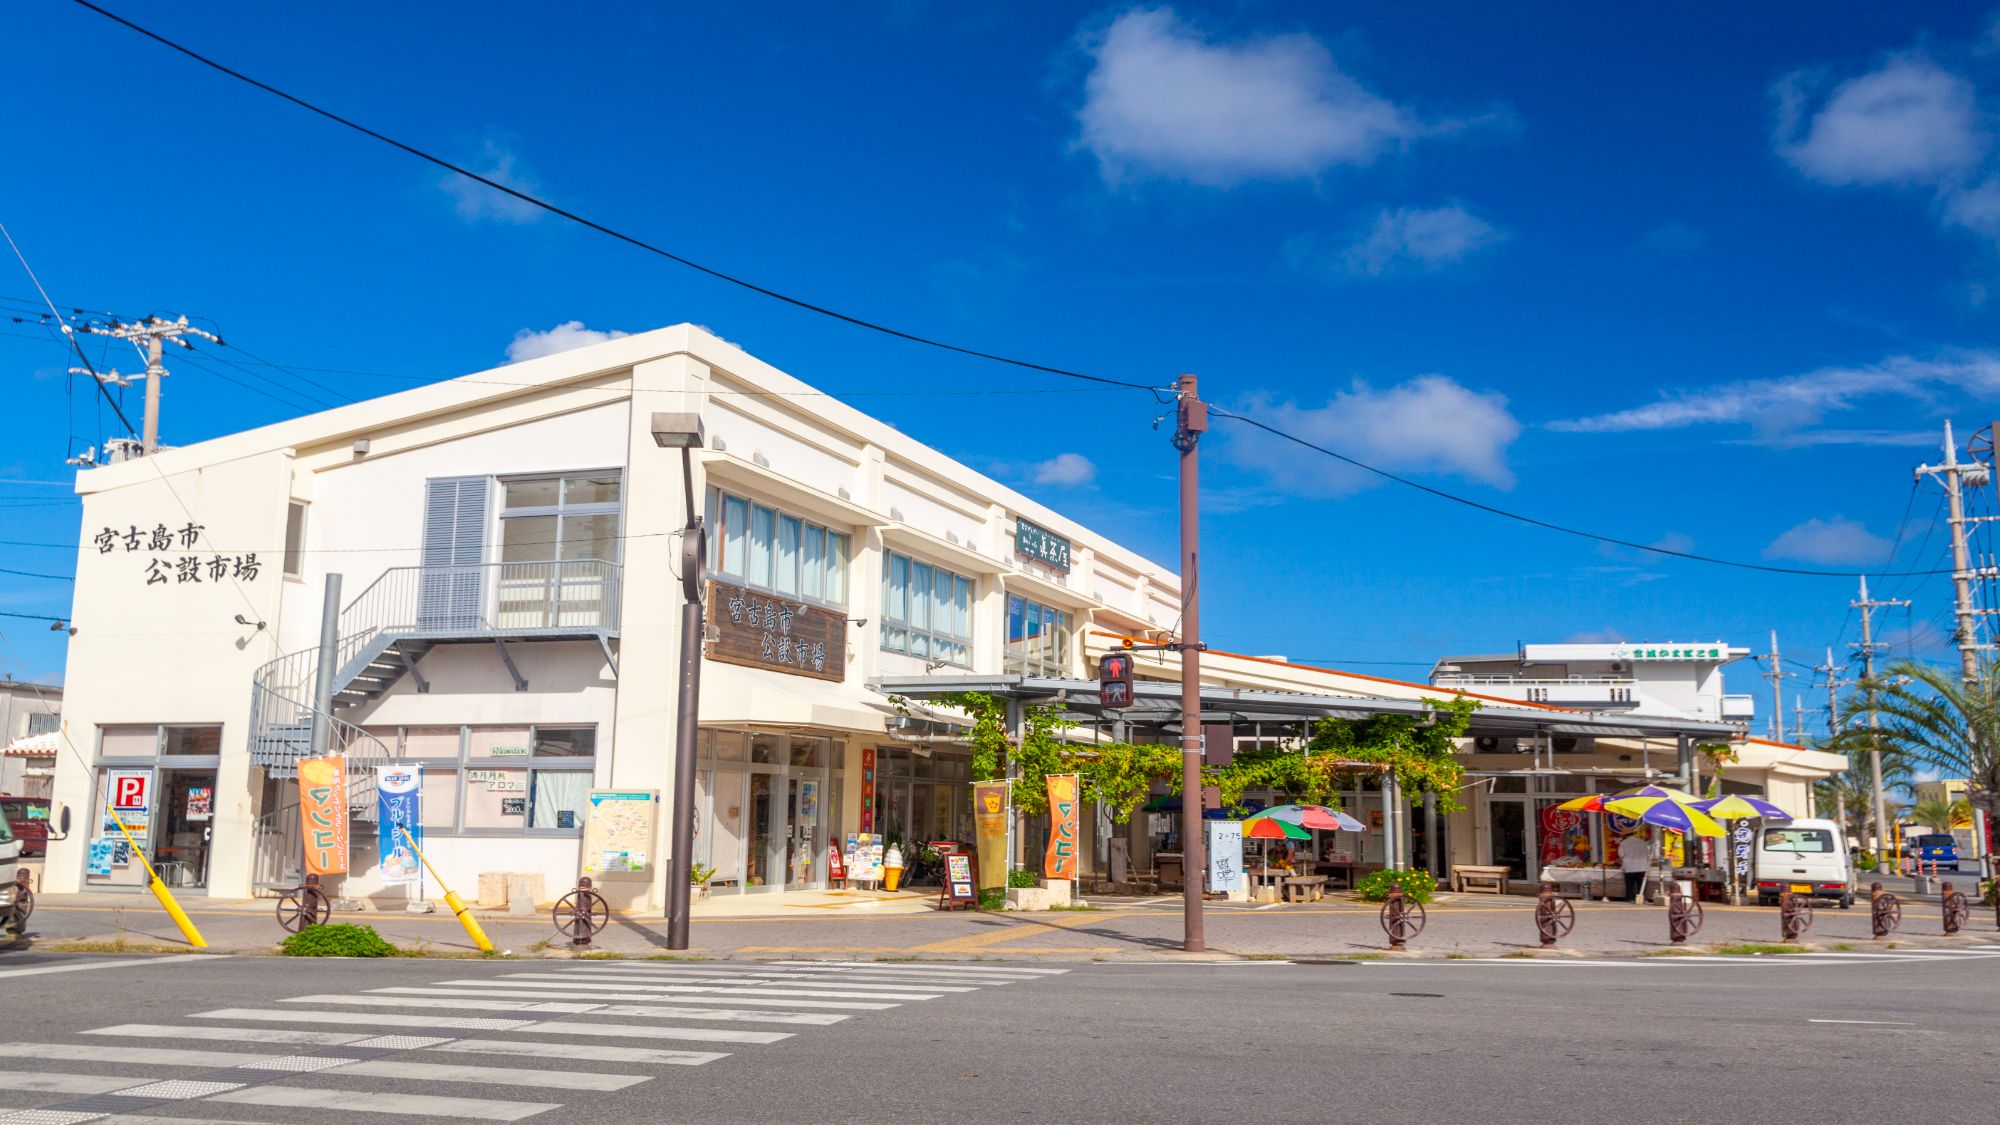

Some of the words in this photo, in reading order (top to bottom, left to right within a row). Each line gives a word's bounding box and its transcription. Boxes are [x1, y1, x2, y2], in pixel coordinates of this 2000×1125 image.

[94, 522, 205, 554] 宮古島市
[145, 553, 262, 586] 公設市場
[729, 597, 793, 635] 宮古島市
[762, 631, 827, 671] 公設市場
[120, 779, 140, 806] P
[488, 781, 515, 790] アロマ
[310, 787, 335, 870] マンゴー
[390, 796, 405, 858] ブルーシール
[1056, 802, 1072, 873] マンゴー
